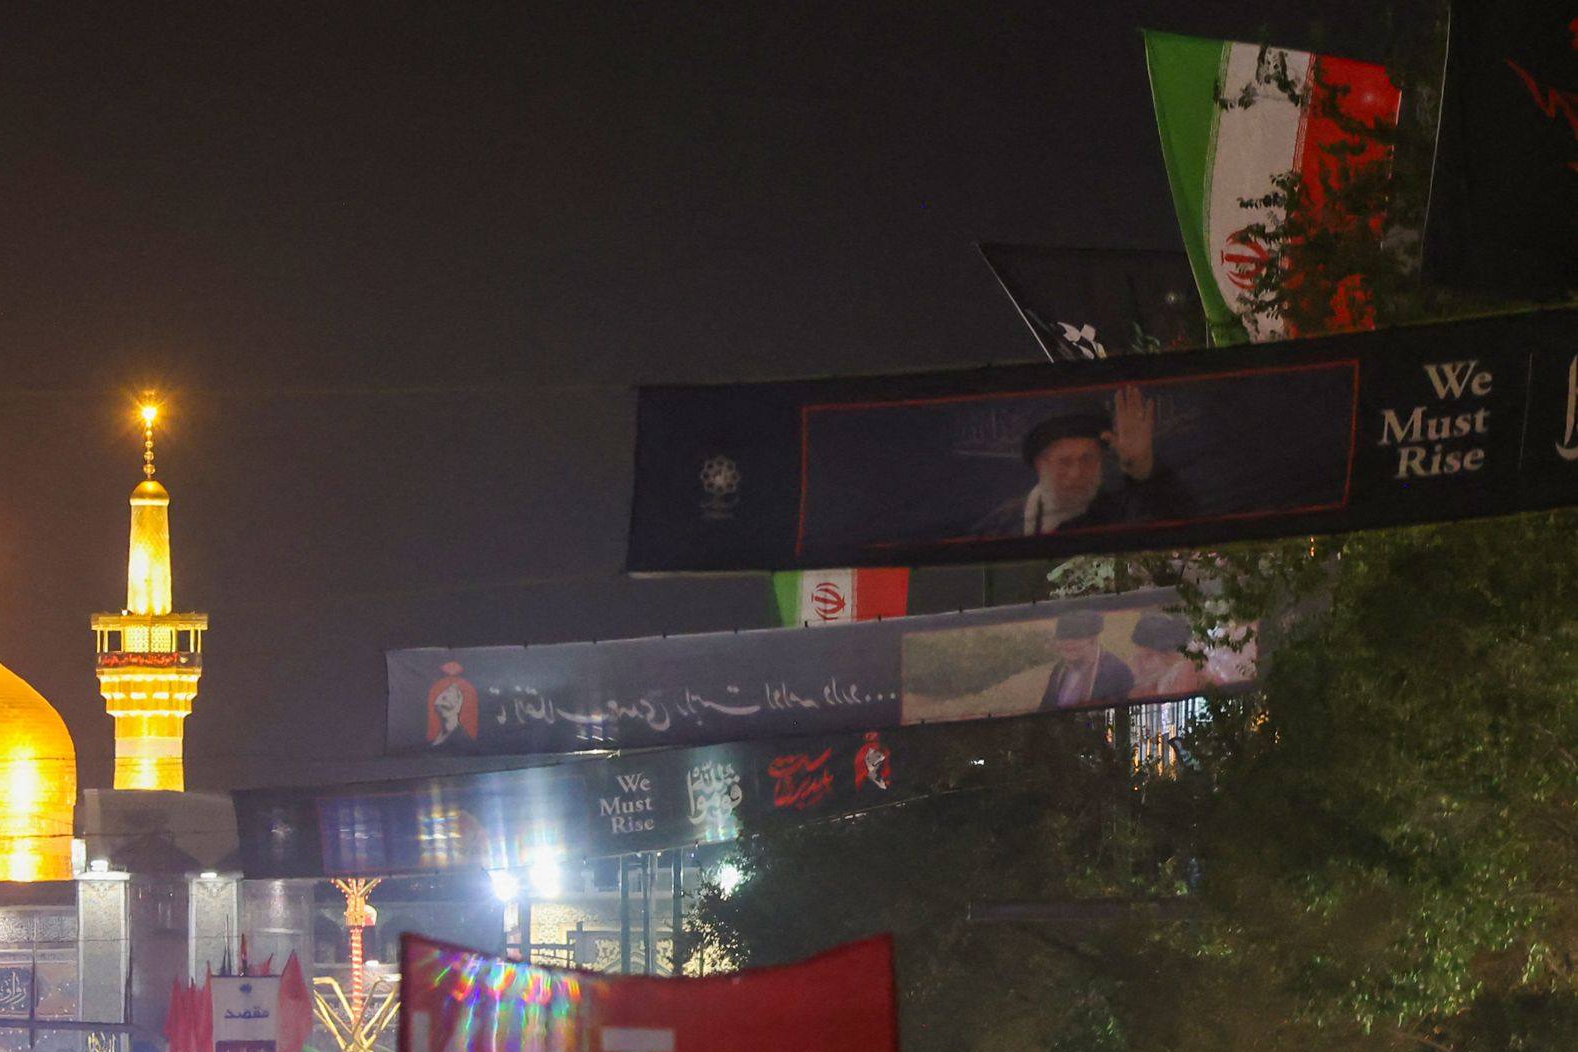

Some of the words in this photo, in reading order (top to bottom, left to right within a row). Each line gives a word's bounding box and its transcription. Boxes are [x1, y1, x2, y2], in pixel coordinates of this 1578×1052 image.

[1423, 360, 1493, 399] We
[1378, 406, 1491, 447] Must
[1392, 443, 1487, 479] Rise
[615, 771, 652, 793] We
[599, 797, 654, 817] Must
[611, 814, 655, 834] Rise
[224, 1006, 270, 1020] مقصد
